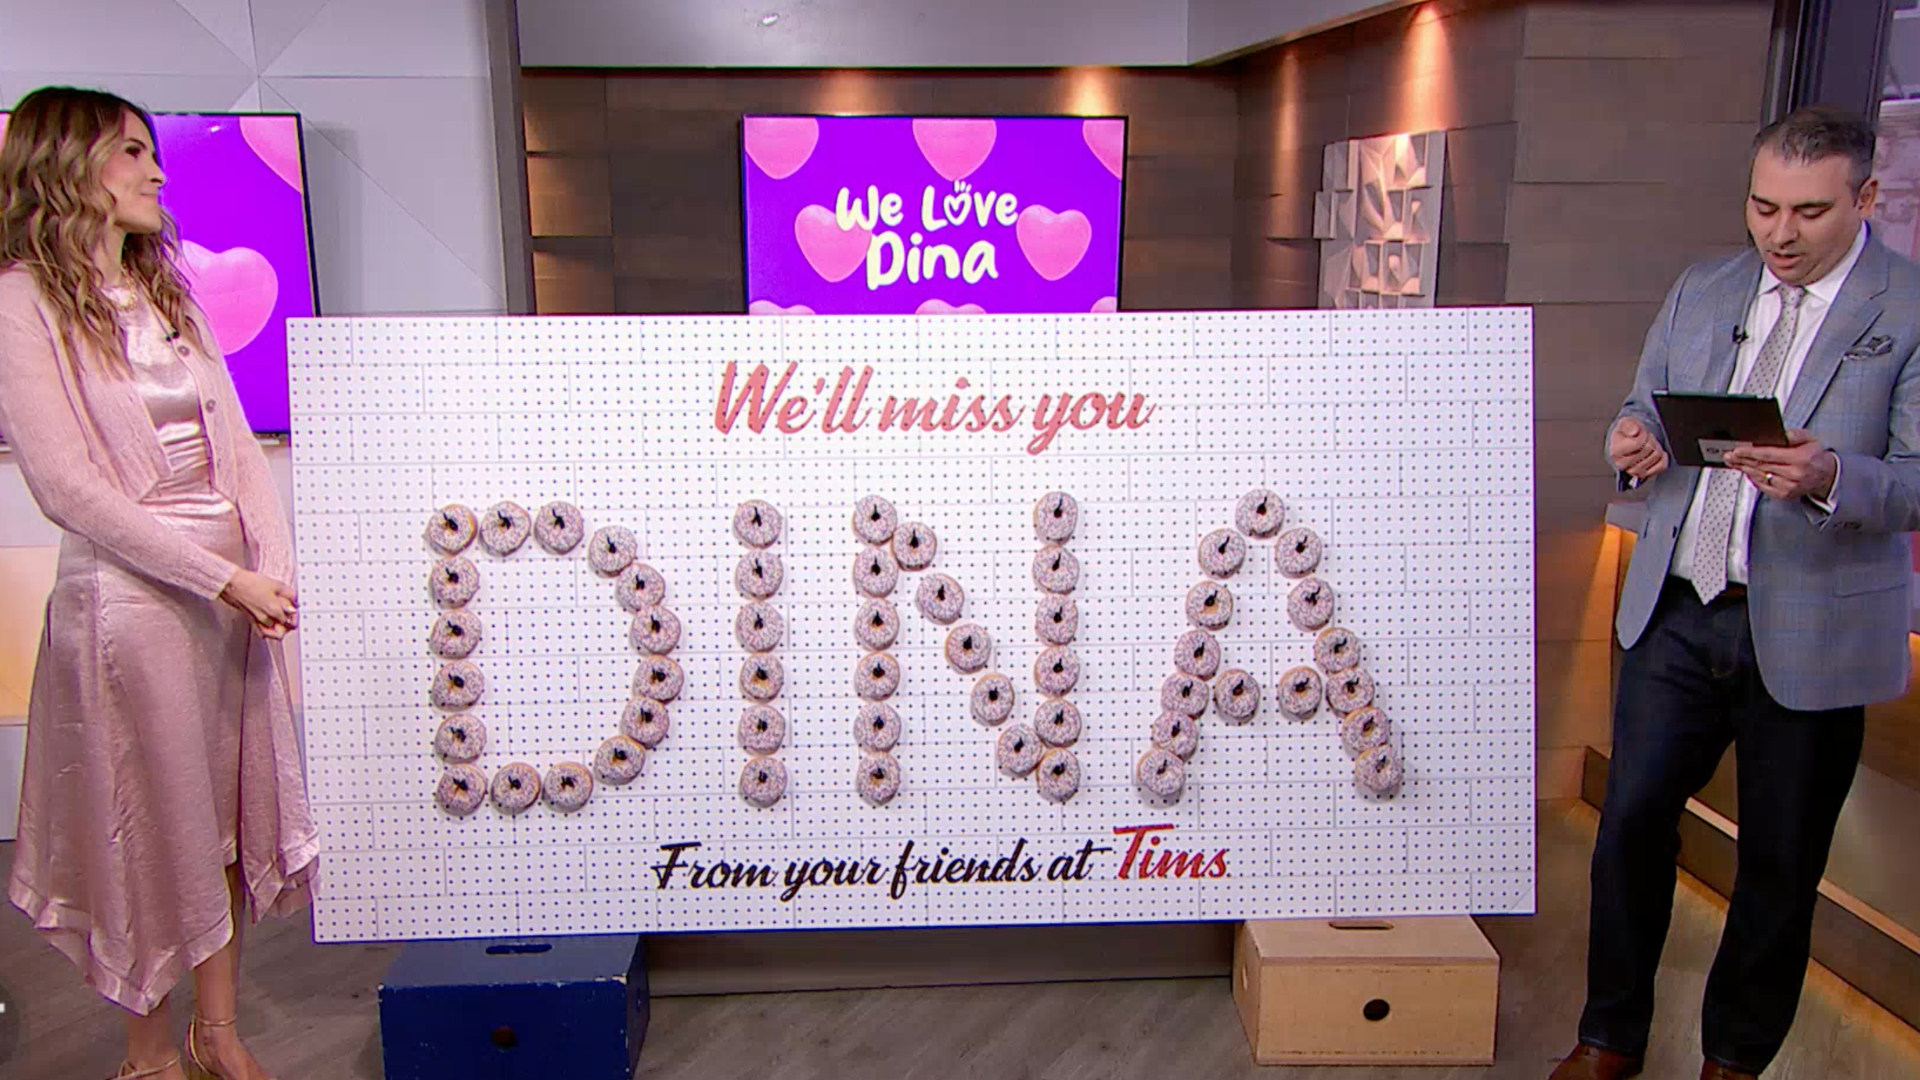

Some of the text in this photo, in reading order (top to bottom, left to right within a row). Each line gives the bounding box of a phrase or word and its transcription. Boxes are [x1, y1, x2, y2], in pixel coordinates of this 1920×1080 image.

[835, 180, 1018, 231] We Love
[866, 231, 999, 290] Dina
[714, 360, 1157, 455] We'll miss you
[423, 489, 1402, 816] DINA
[650, 823, 1231, 902] From your friends at Tims
